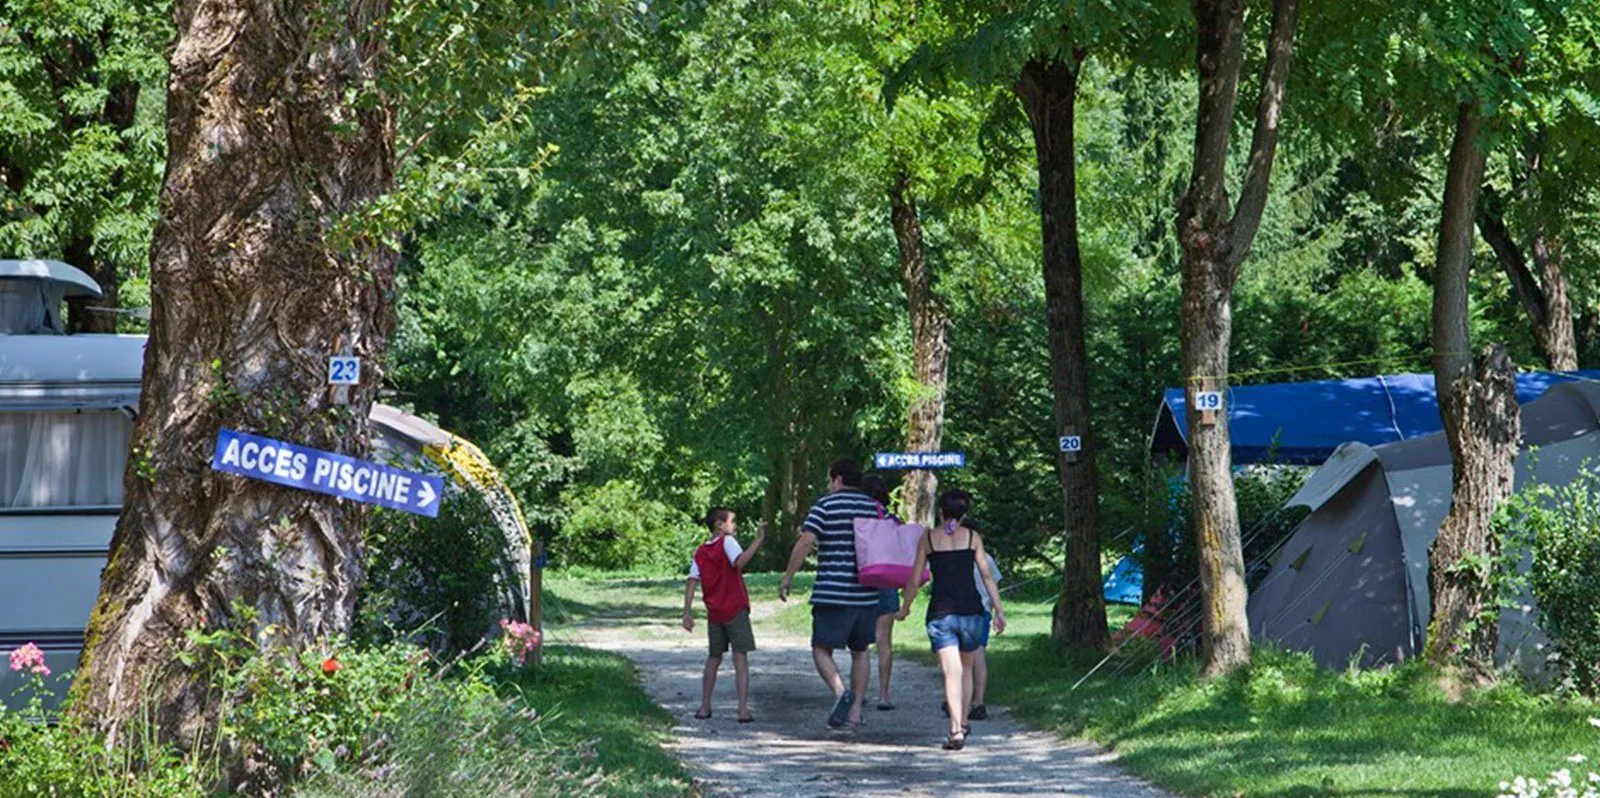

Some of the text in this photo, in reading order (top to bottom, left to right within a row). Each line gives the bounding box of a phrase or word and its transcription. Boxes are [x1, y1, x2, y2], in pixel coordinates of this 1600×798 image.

[331, 360, 357, 380] 23
[1198, 394, 1219, 407] 19
[1062, 437, 1079, 449] 20
[922, 454, 961, 466] PISCINE
[221, 438, 412, 504] ACCES PISCINE
